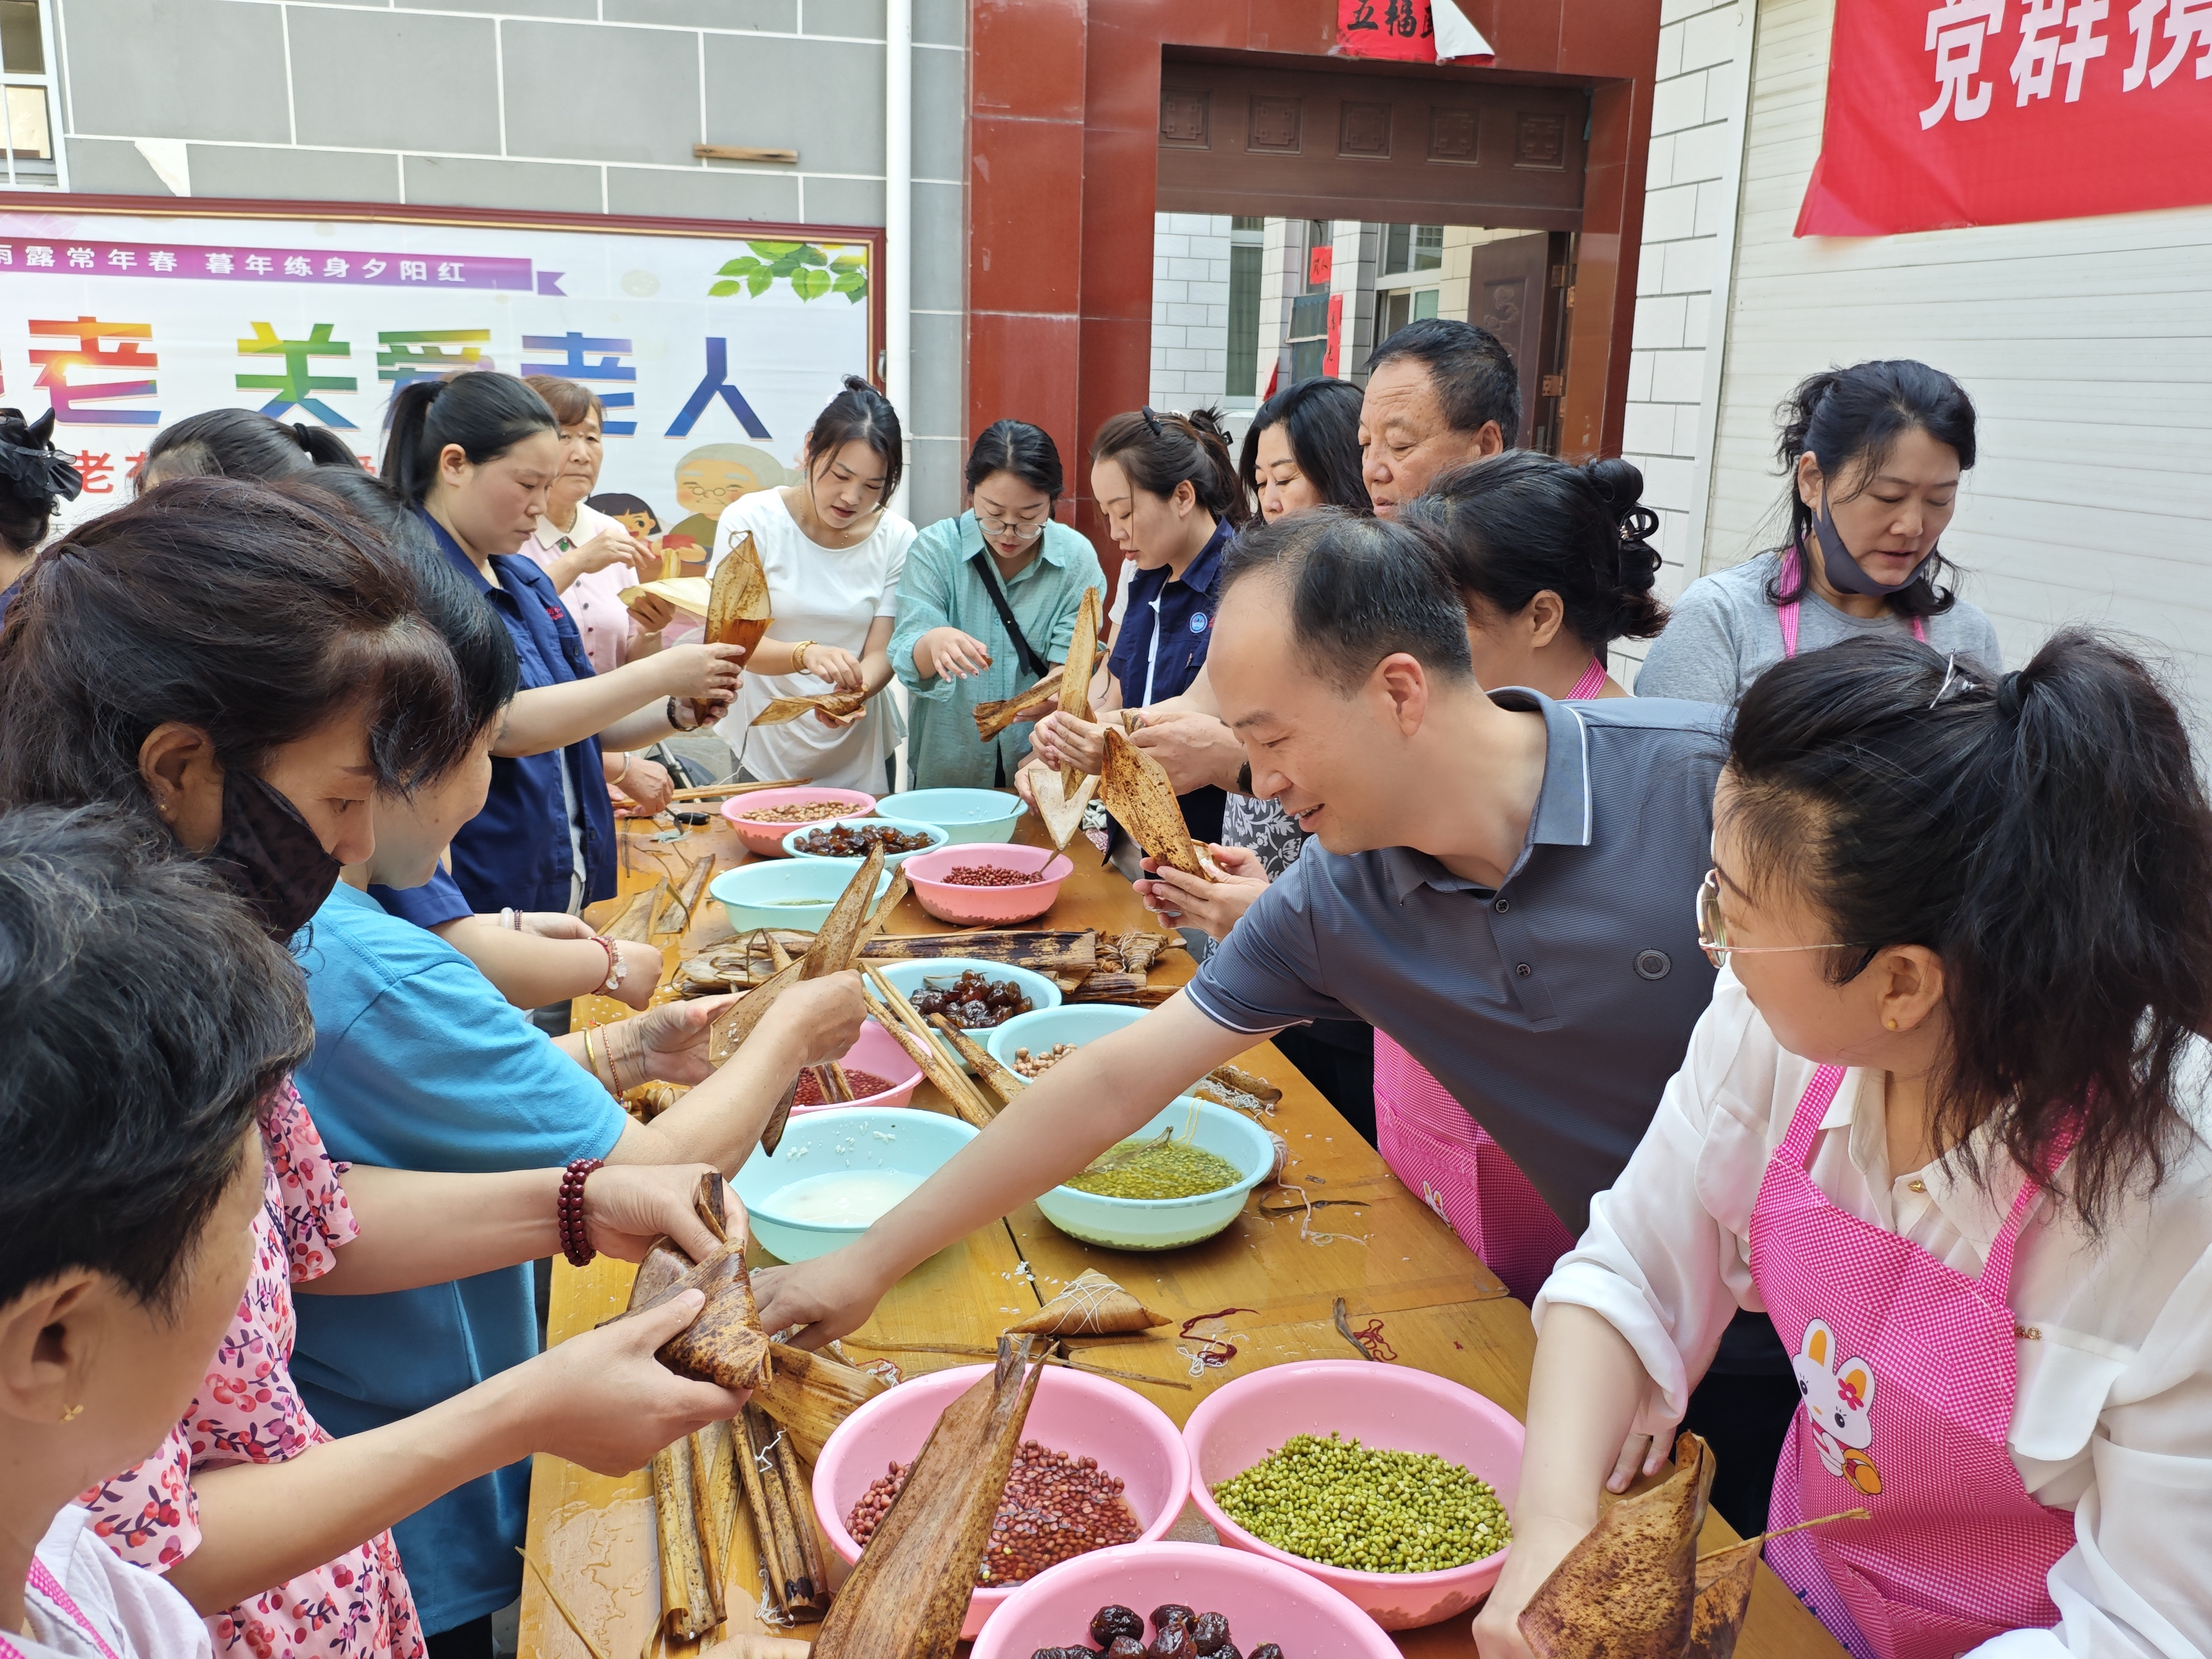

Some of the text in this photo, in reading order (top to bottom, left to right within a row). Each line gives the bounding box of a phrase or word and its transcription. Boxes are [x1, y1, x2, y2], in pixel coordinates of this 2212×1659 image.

[205, 253, 466, 282] 暮年练身夕阳红
[0, 316, 161, 428] 老
